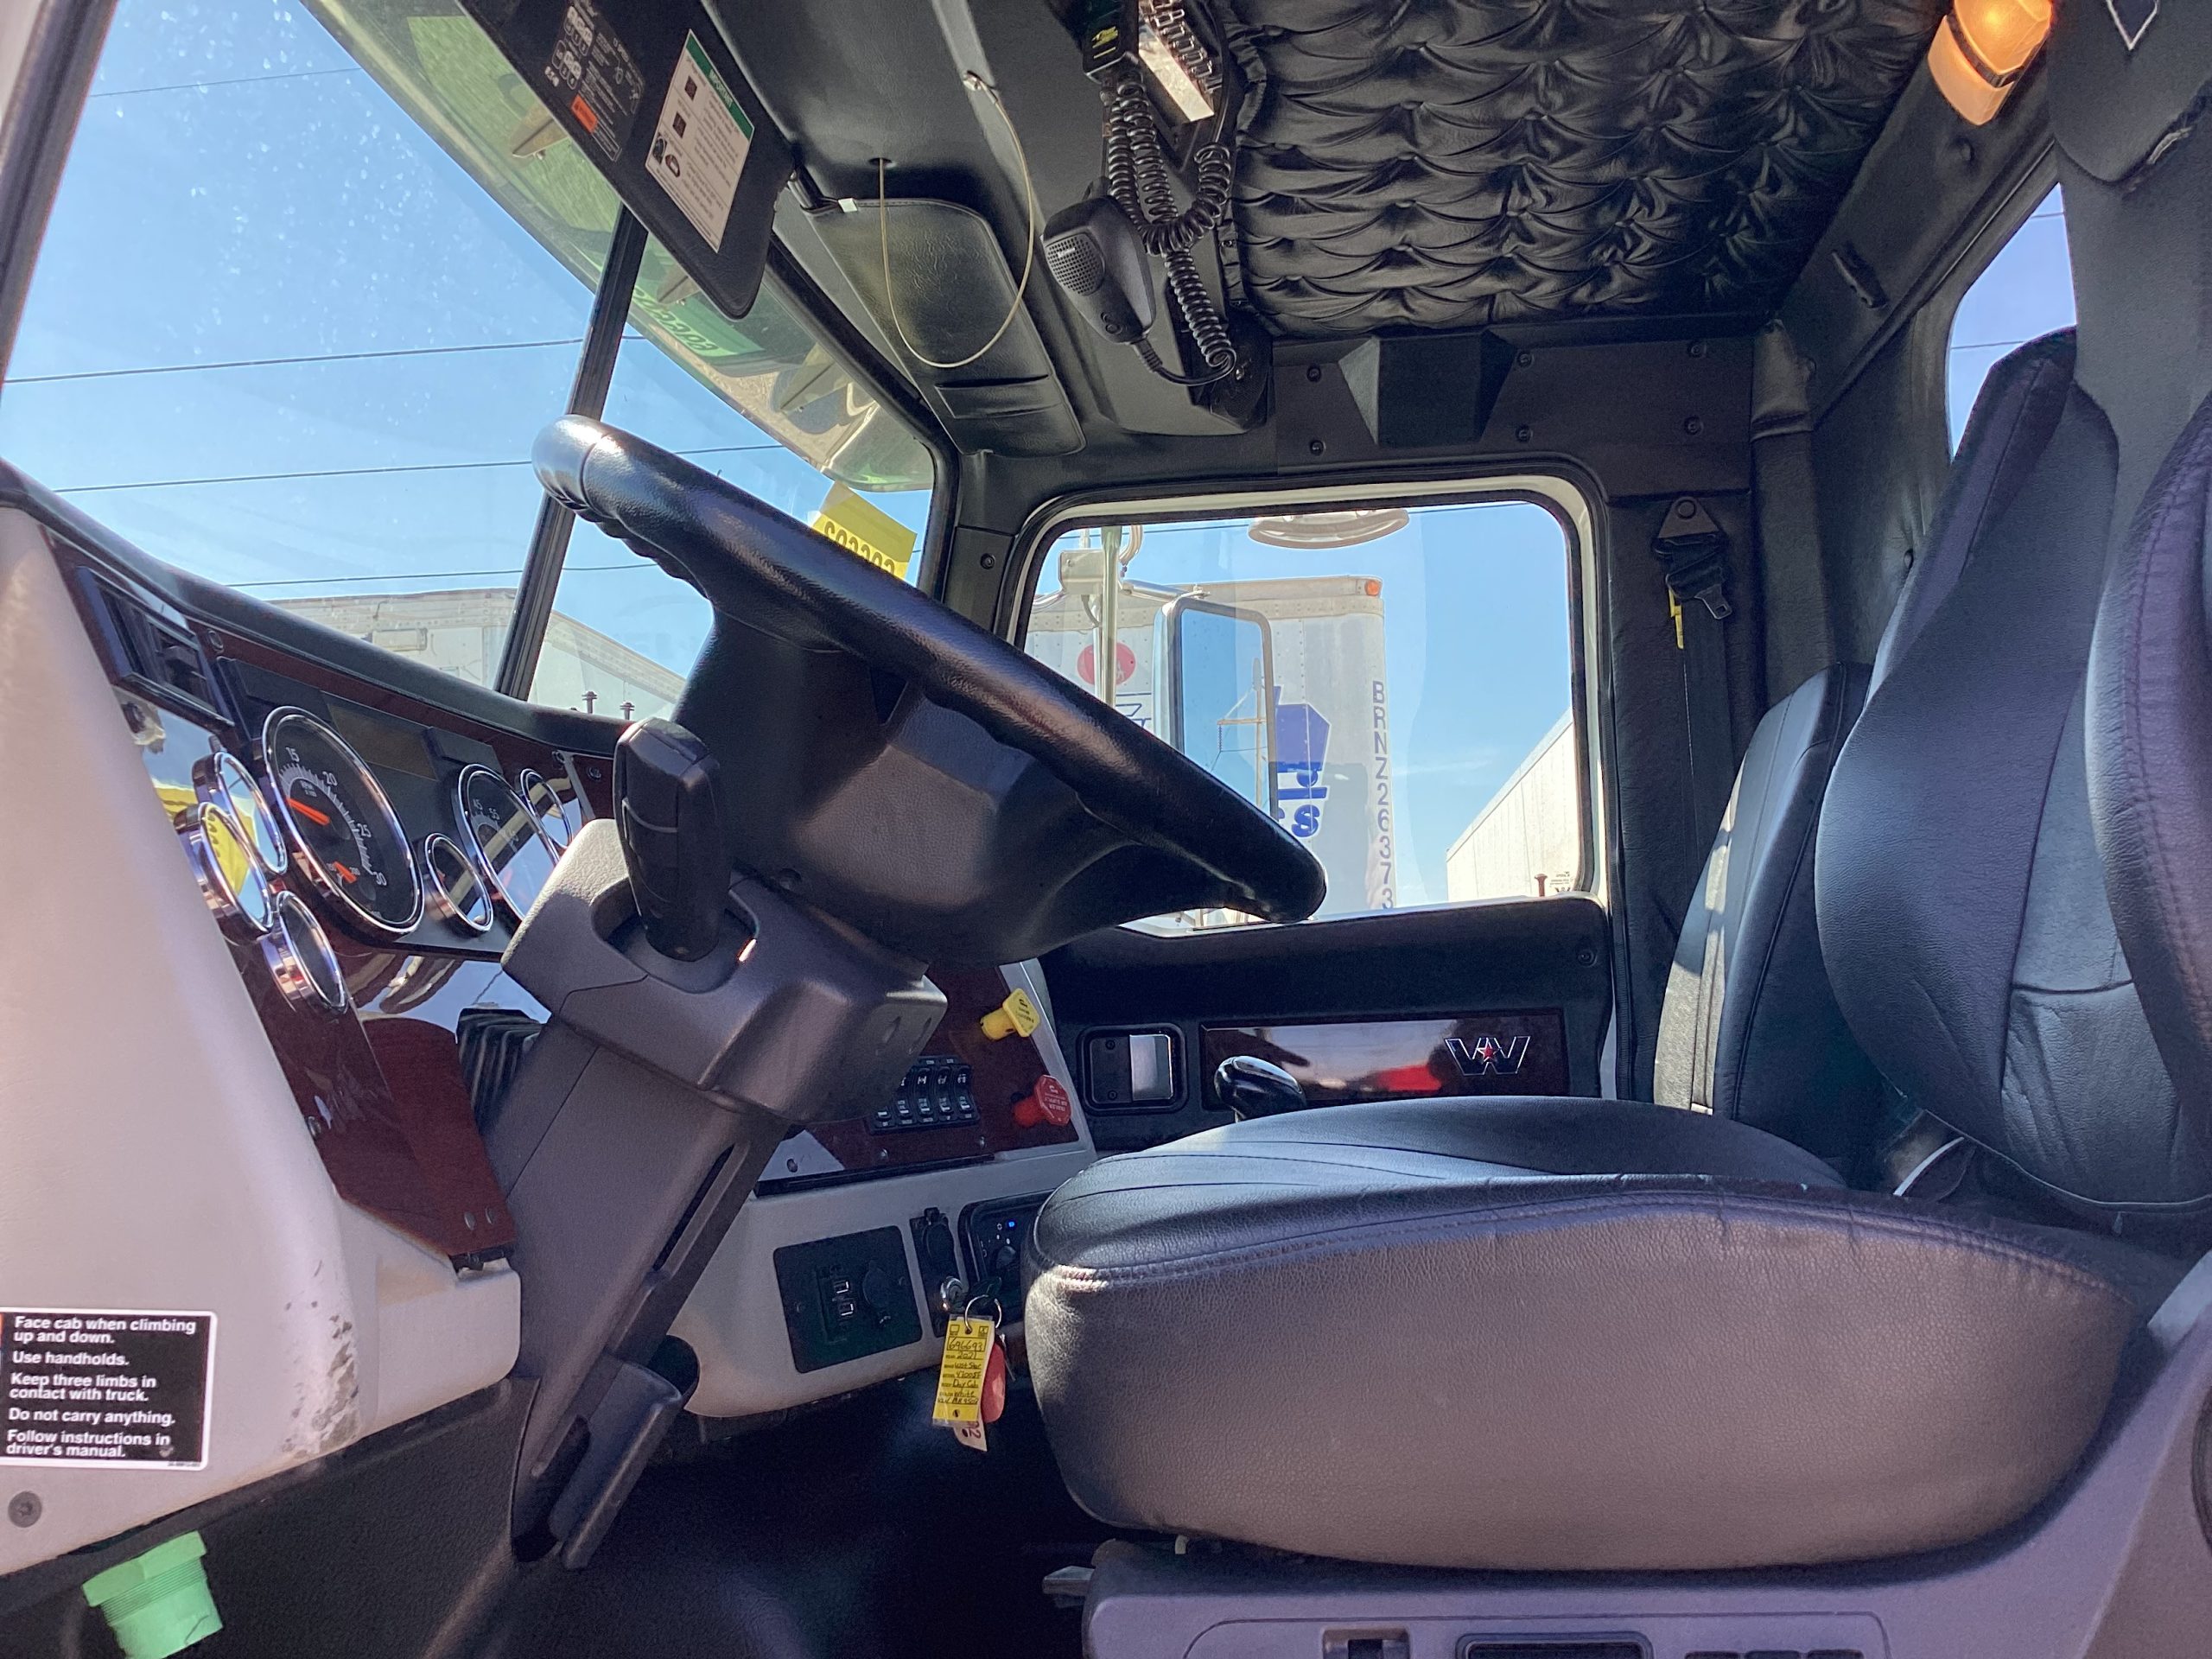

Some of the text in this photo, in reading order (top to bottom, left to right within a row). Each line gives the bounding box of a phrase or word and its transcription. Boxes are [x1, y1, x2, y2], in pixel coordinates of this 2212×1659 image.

[285, 747, 300, 762] 15
[322, 771, 338, 786] 20
[357, 823, 372, 838] 25
[372, 871, 387, 886] 30
[15, 1315, 197, 1335] Face cab when climbing
[13, 1330, 116, 1344] up and down.
[12, 1351, 130, 1365] Use handholds.
[10, 1372, 157, 1388] Keep three limbs in
[9, 1388, 149, 1402] contact with truck.
[8, 1408, 176, 1427] Do not carry anything.
[7, 1429, 171, 1446] Follow instructions in
[6, 1442, 126, 1458] driver's manual.
